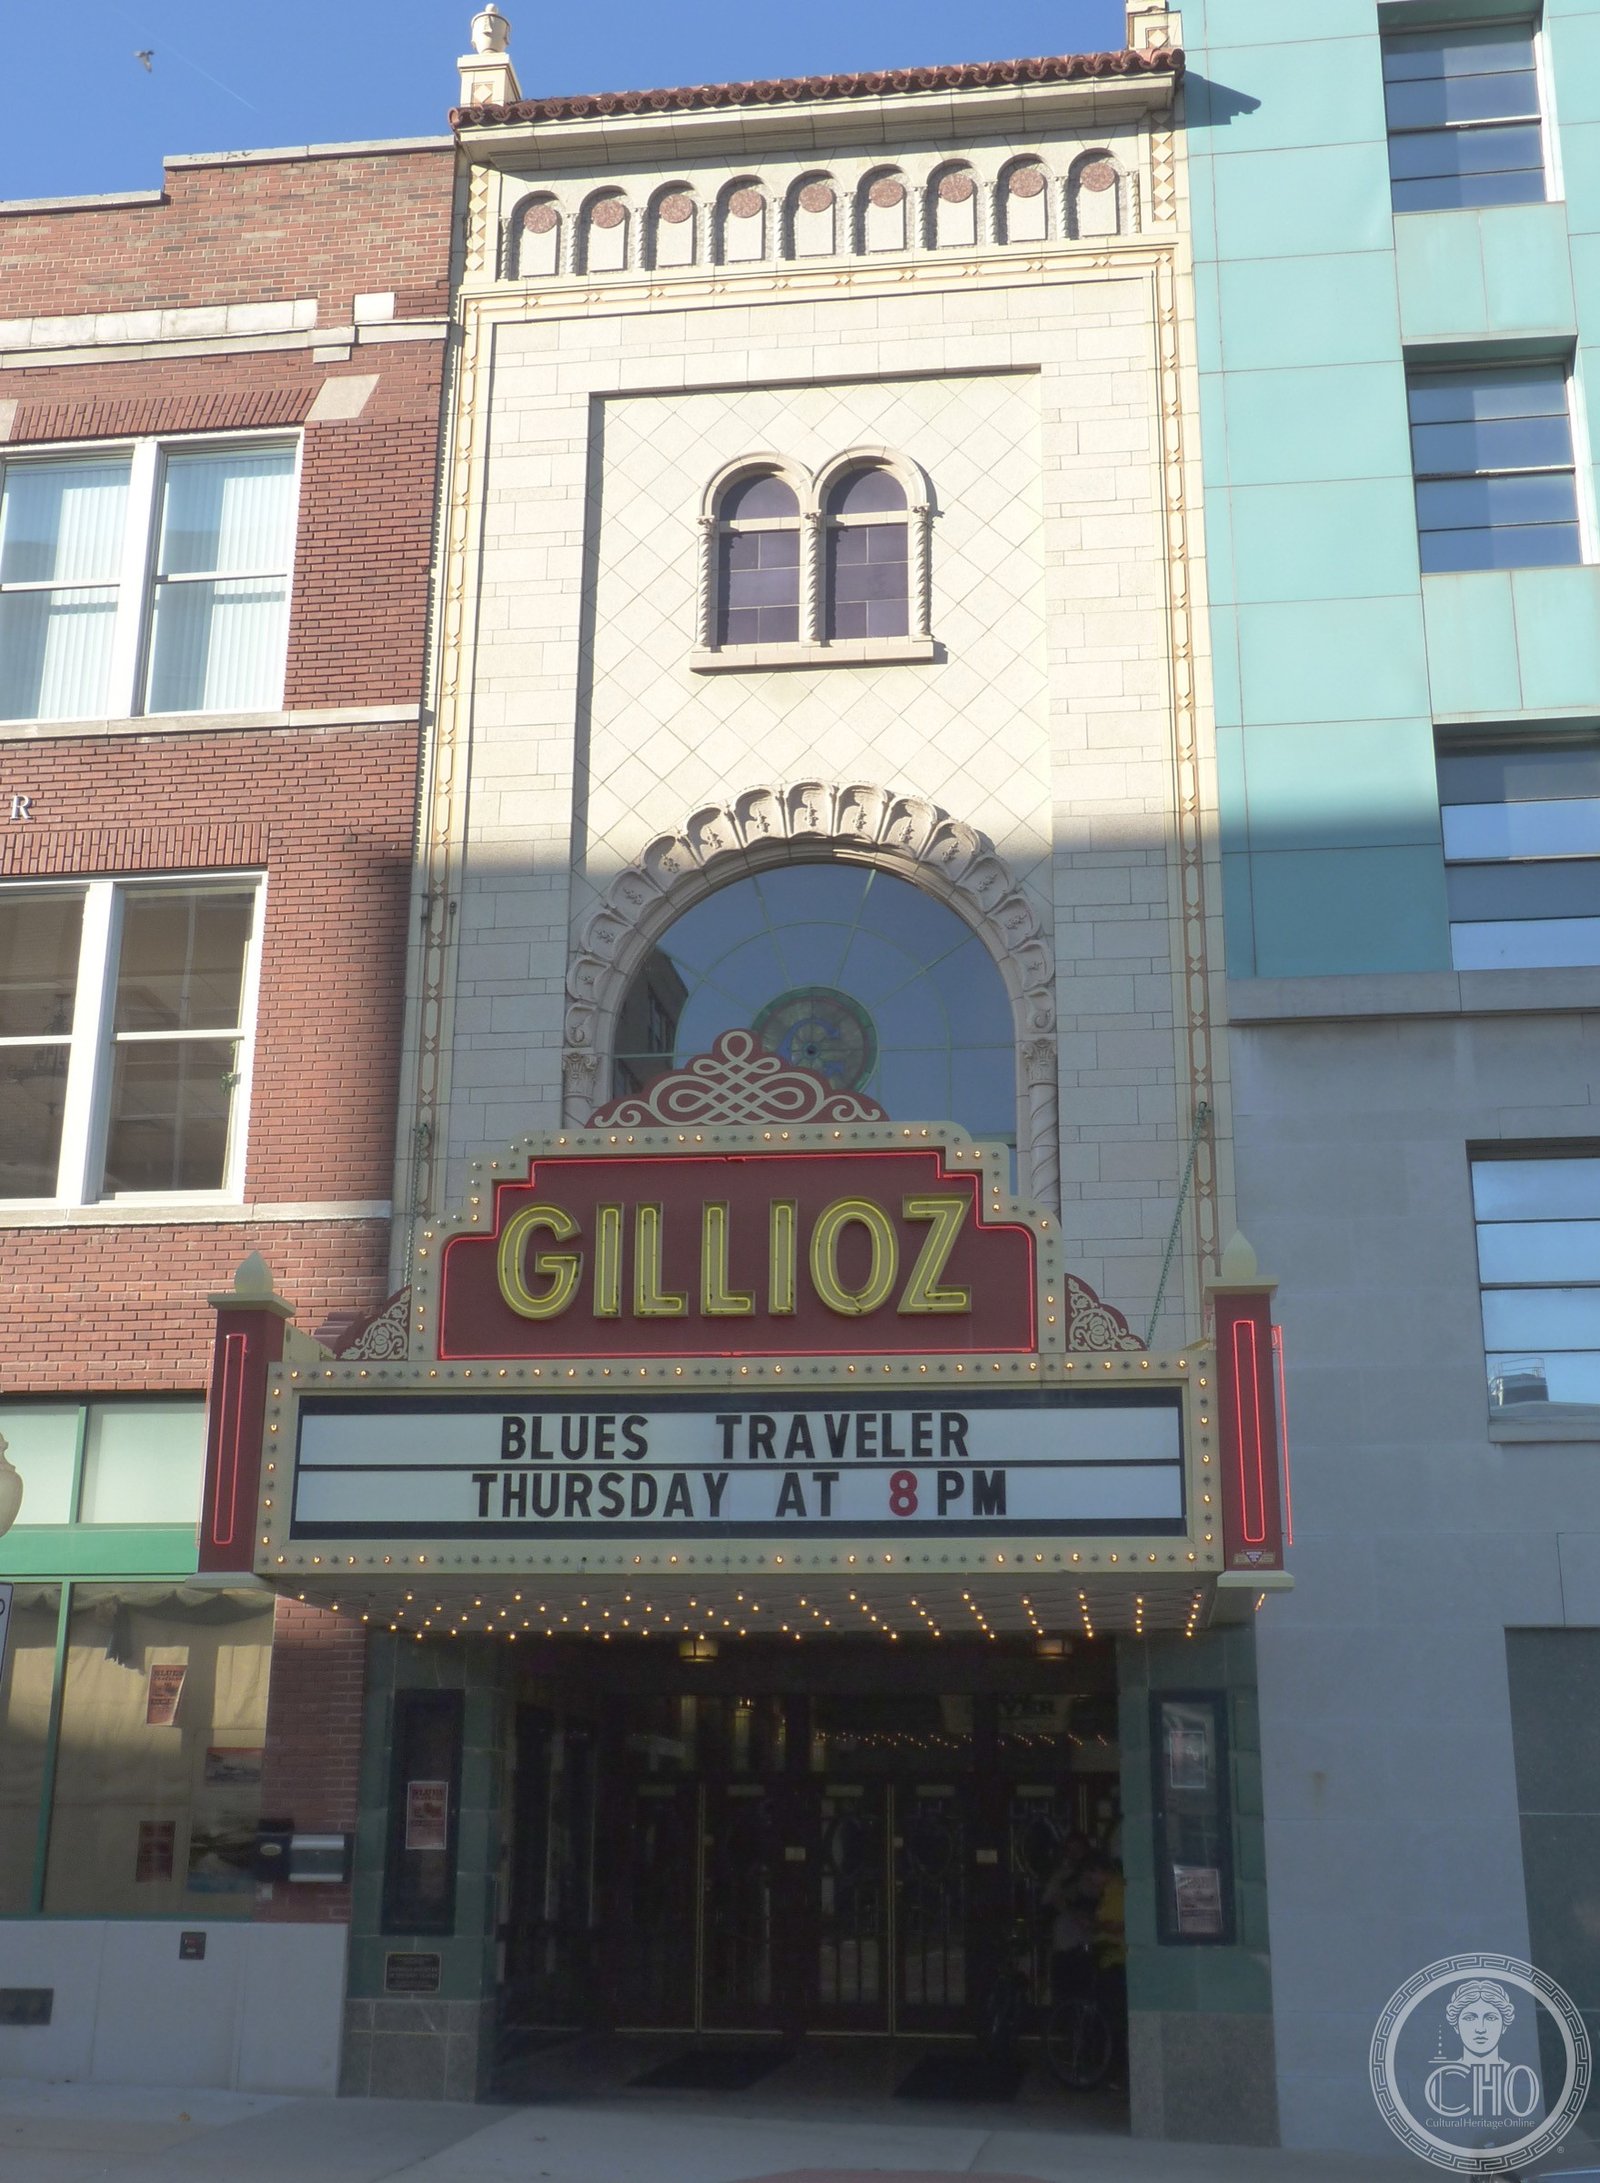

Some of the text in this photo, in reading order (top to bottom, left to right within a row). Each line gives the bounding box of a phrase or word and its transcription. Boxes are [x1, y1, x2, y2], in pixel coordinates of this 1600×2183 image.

[497, 1191, 974, 1319] GILLIOZ
[500, 1411, 969, 1460] BLUES TRAVELER
[472, 1472, 729, 1518] THURSDAY
[775, 1471, 839, 1517] AT
